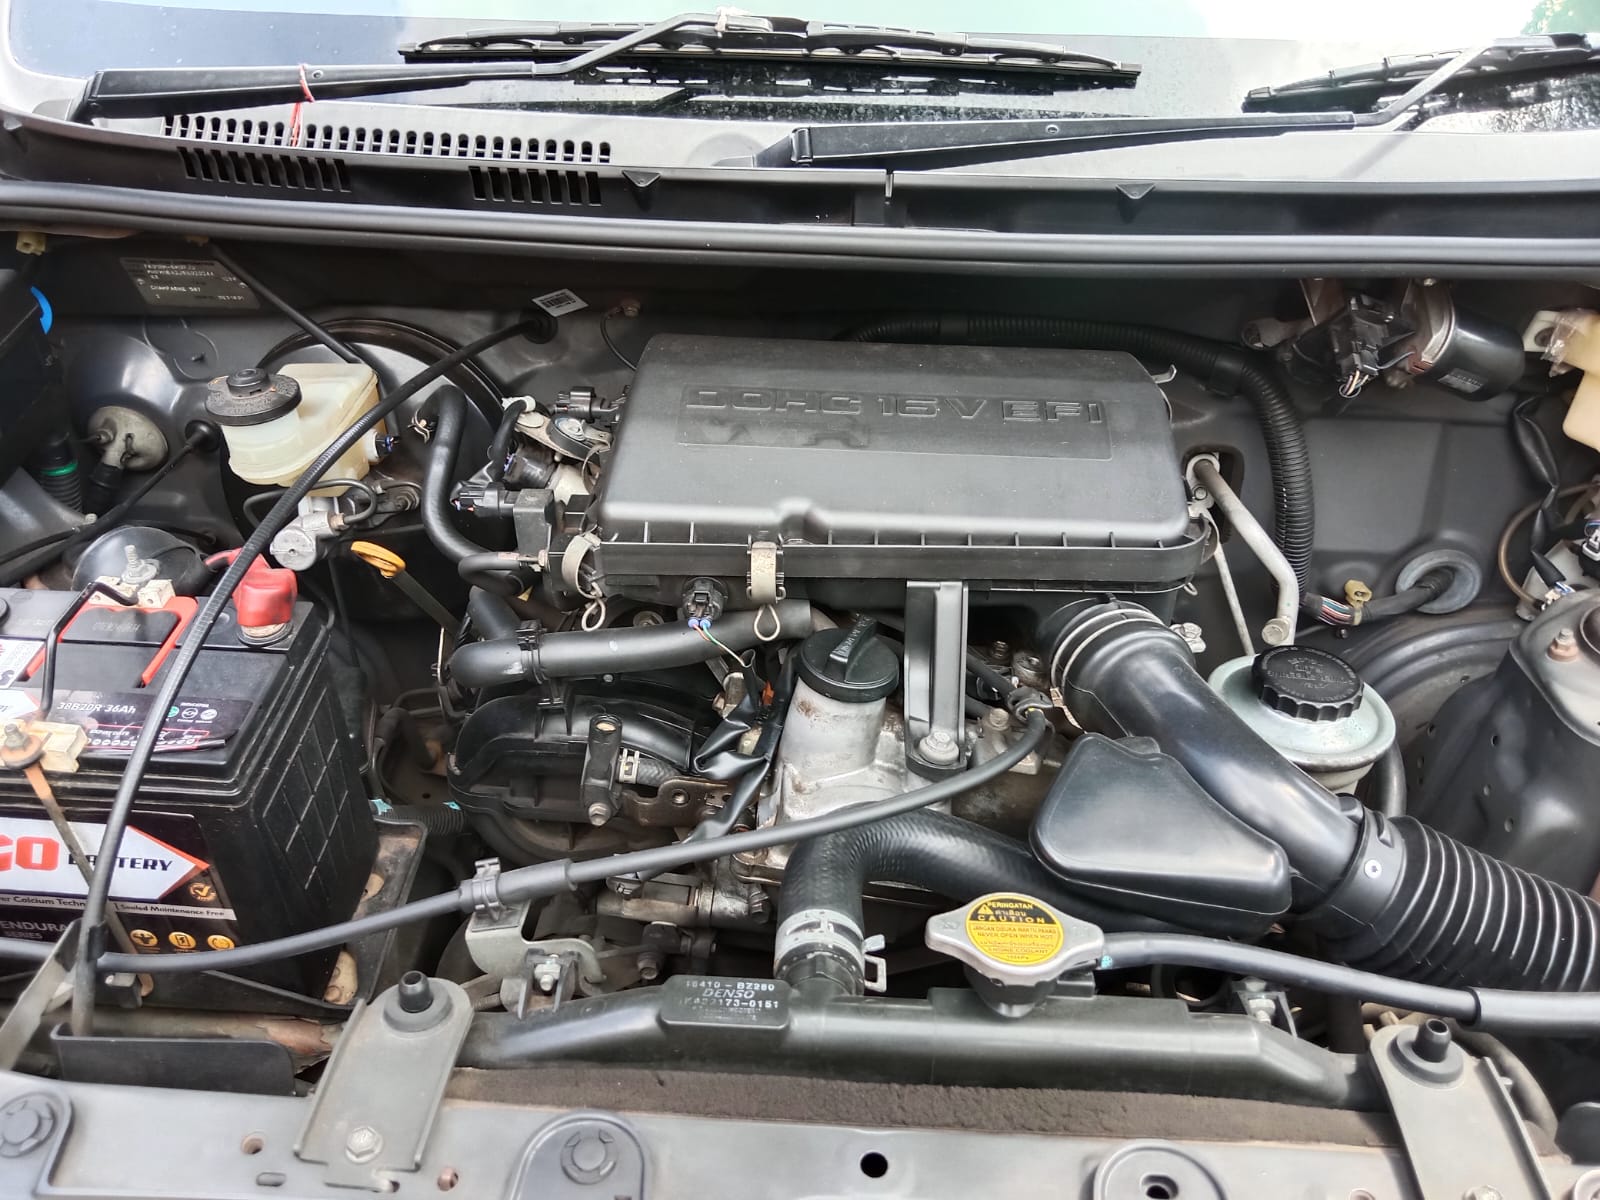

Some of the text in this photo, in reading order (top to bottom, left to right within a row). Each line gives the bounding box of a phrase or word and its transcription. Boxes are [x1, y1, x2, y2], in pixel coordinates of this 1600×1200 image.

[1002, 400, 1102, 424] EFI
[68, 853, 173, 871] BATERY
[13, 896, 54, 905] Calcium
[987, 901, 1034, 910] PERINGATAN
[120, 904, 148, 912] Sealed
[150, 905, 204, 915] Maintenance
[977, 915, 1045, 924] CAUTION
[702, 988, 755, 999] DENSO
